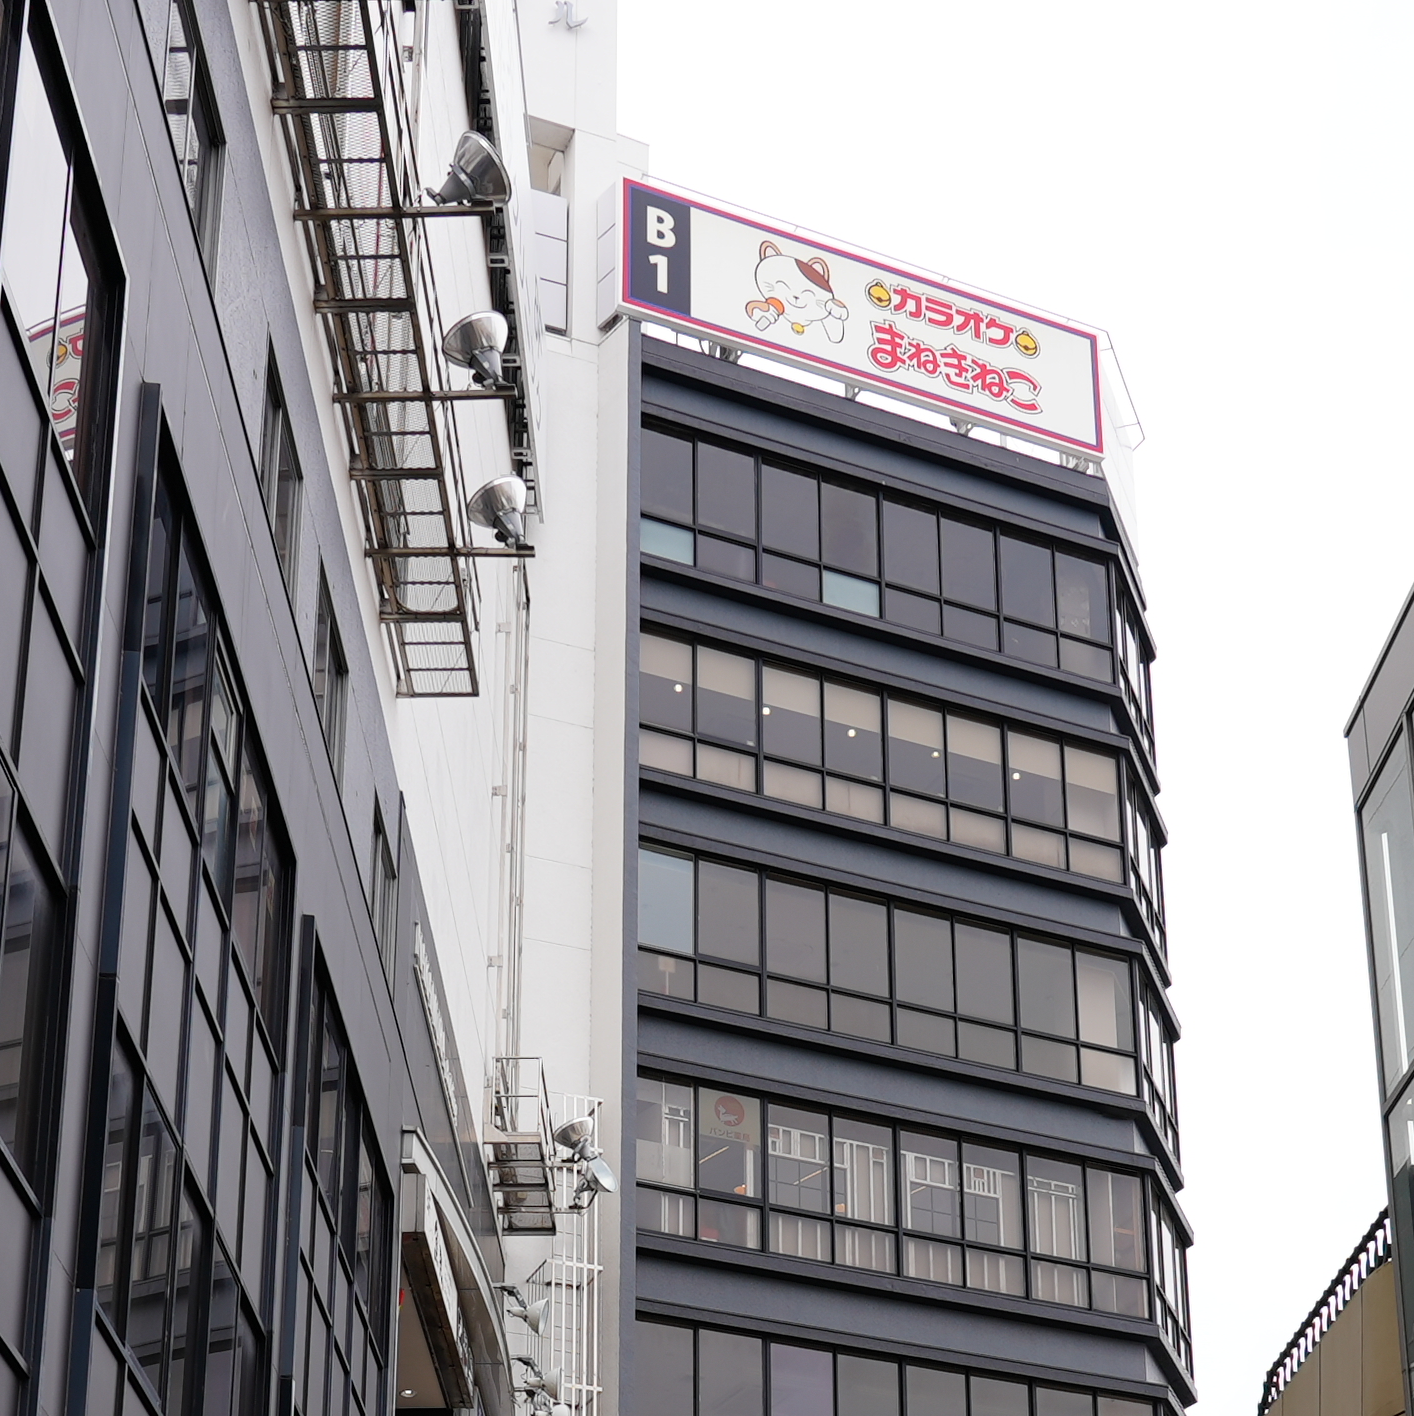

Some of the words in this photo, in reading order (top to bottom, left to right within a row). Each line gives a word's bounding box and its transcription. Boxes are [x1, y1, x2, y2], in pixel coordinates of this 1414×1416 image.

[890, 286, 1014, 347] カラオケ
[869, 323, 1042, 412] まねきねこ
